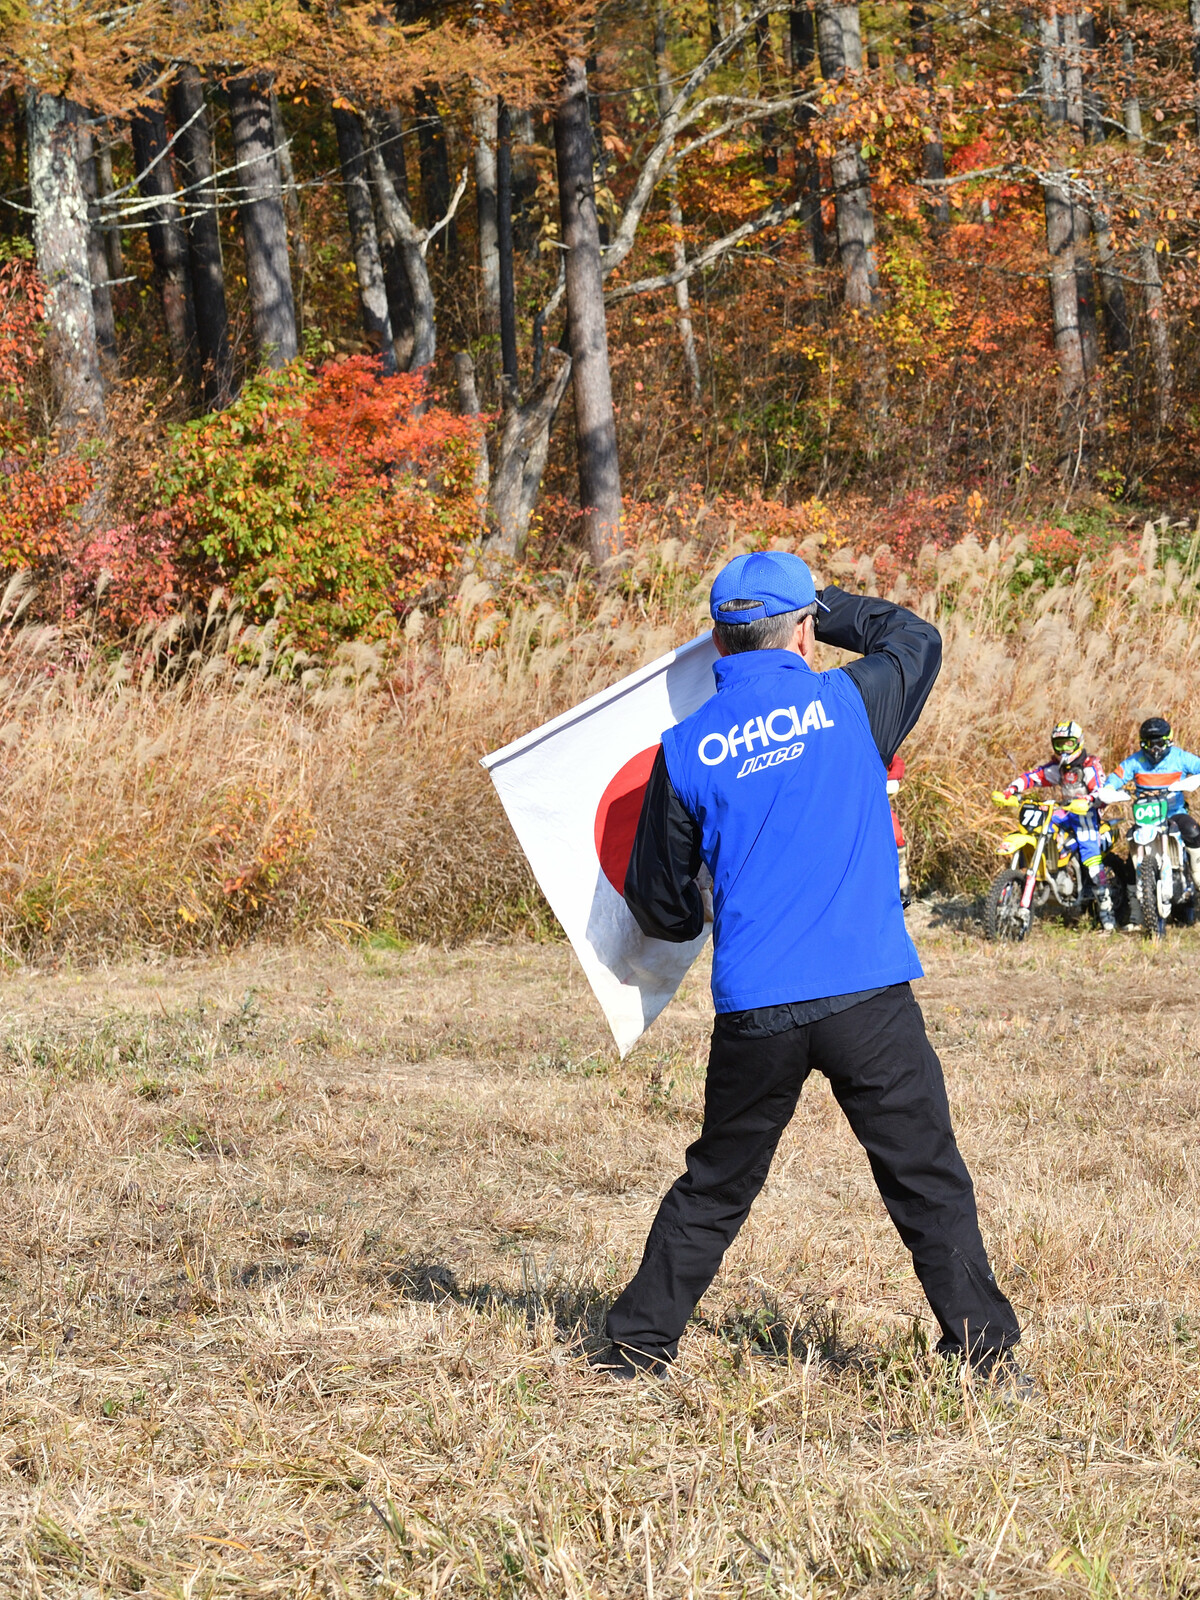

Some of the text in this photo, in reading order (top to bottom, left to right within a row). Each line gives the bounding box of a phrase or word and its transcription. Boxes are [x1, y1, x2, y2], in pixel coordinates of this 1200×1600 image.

[737, 742, 805, 778] JNCC
[1022, 809, 1042, 827] 71
[1135, 805, 1160, 821] 041
